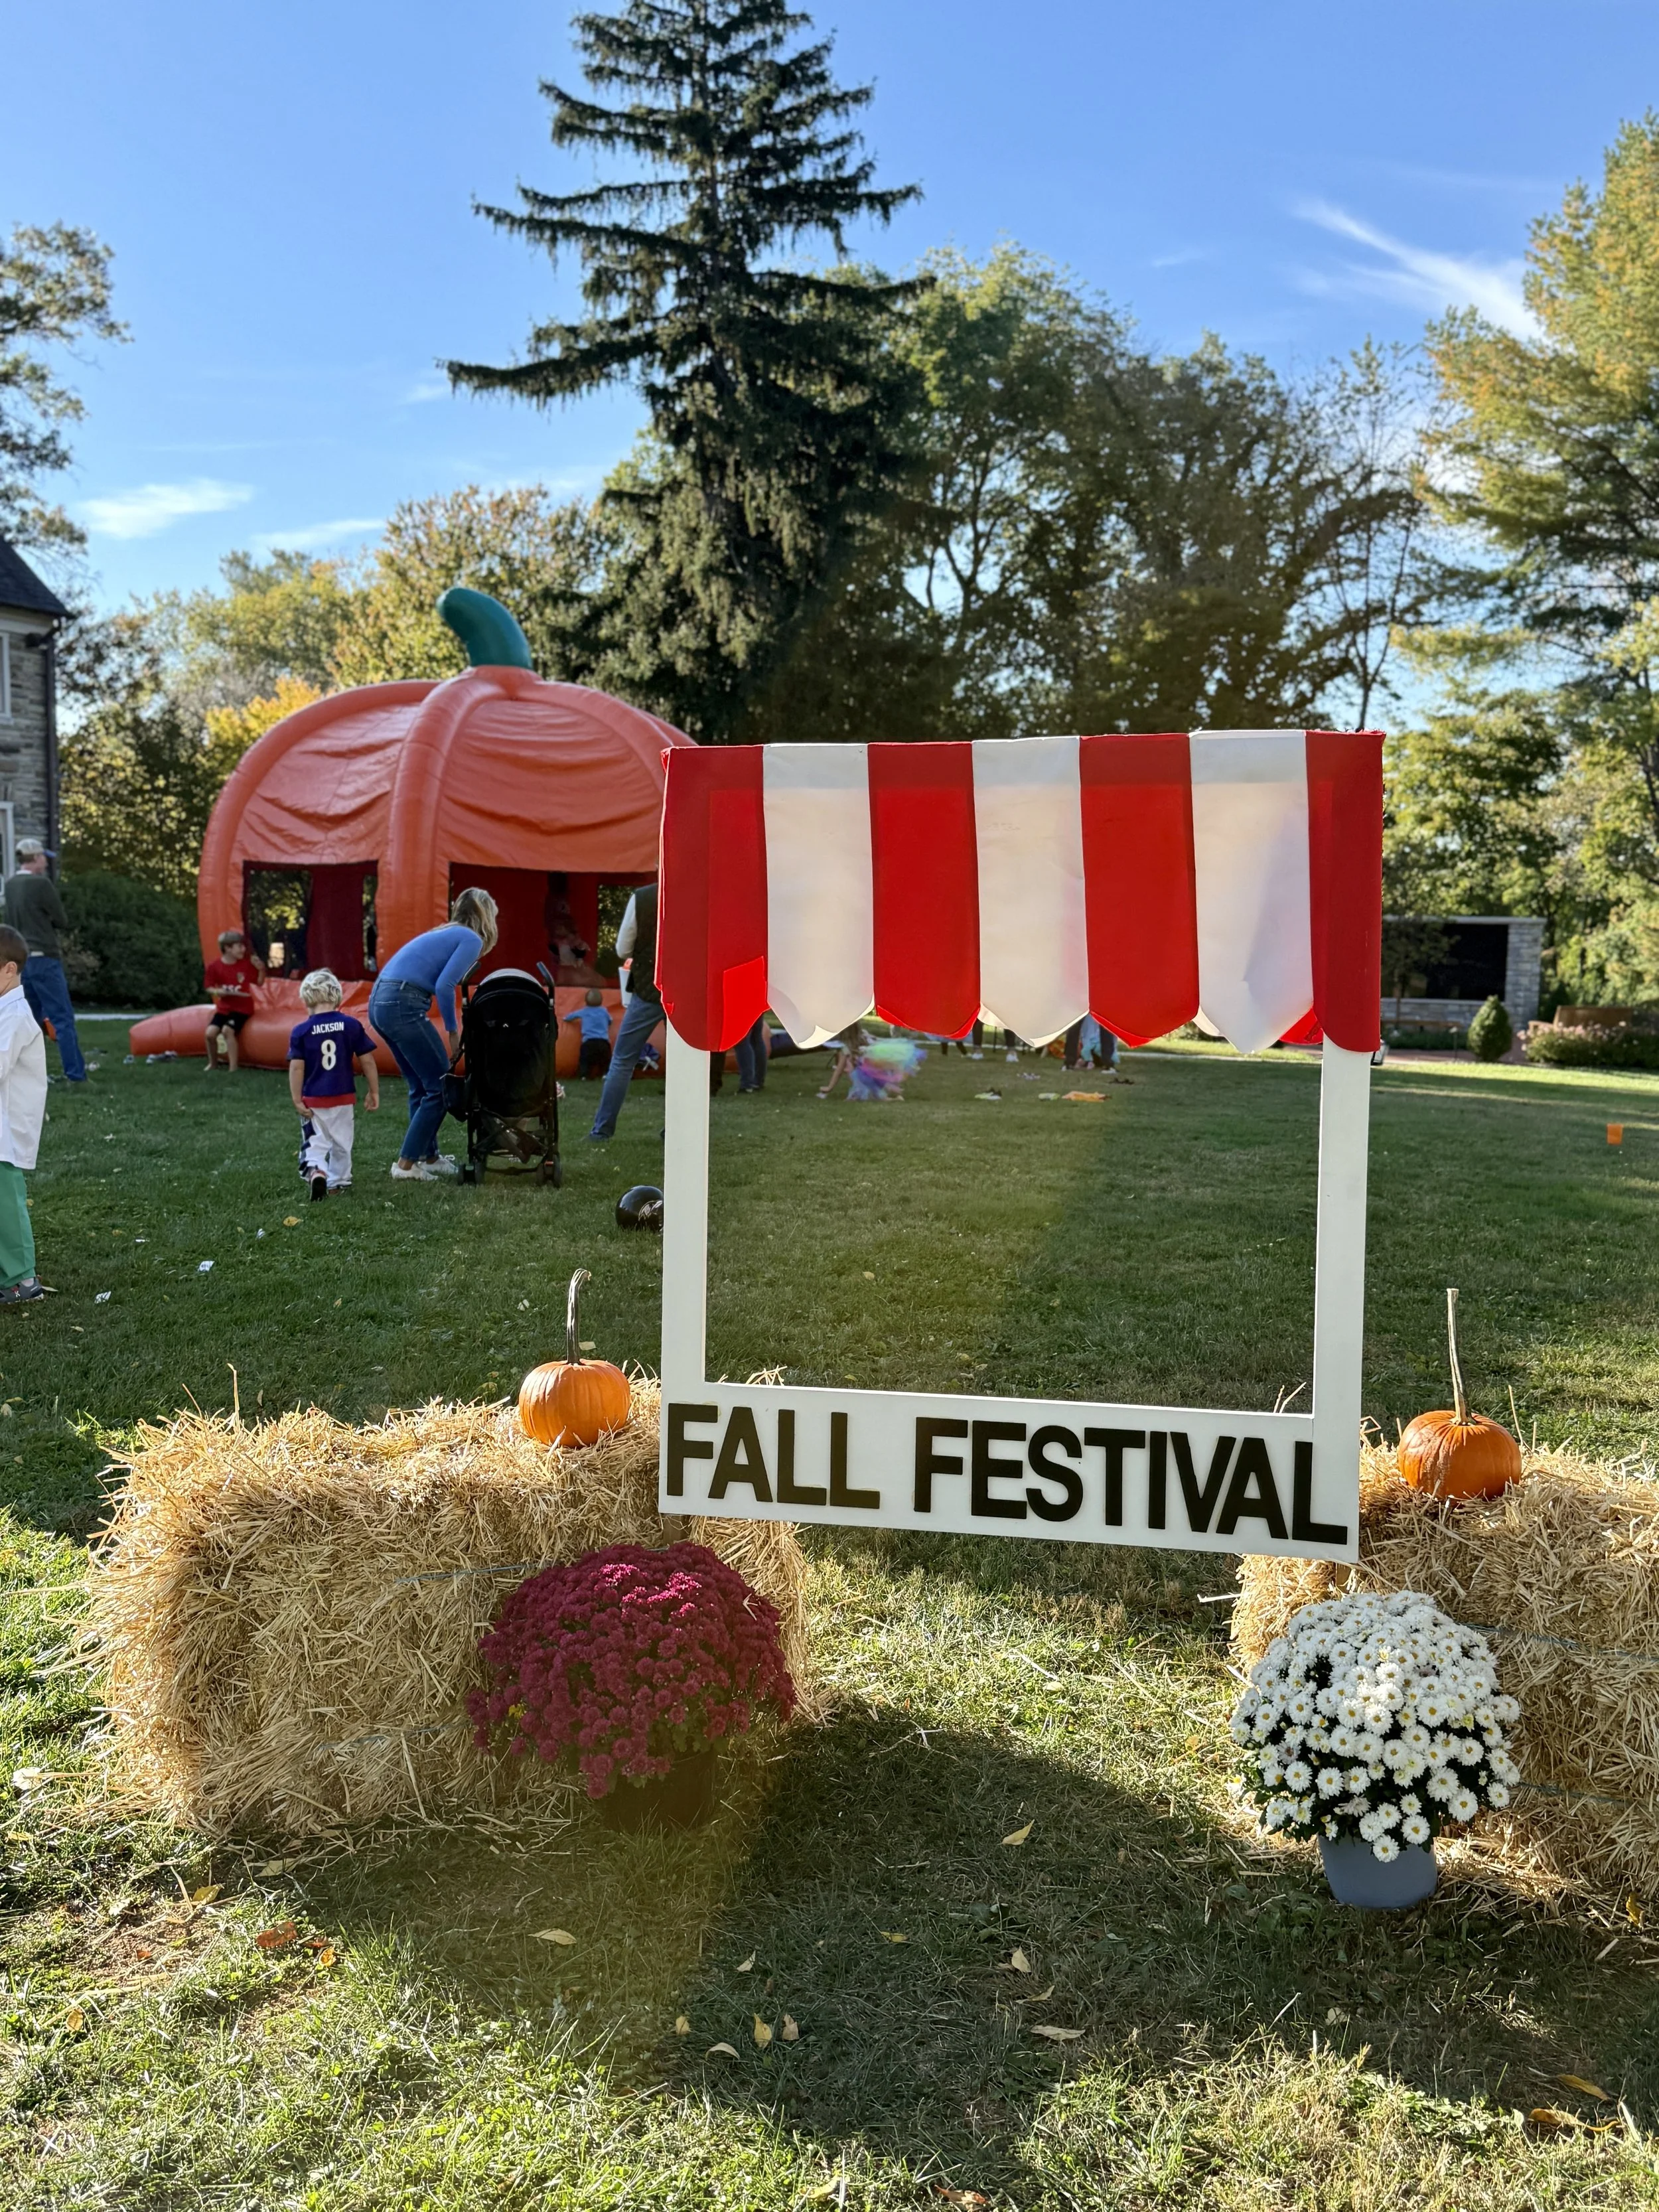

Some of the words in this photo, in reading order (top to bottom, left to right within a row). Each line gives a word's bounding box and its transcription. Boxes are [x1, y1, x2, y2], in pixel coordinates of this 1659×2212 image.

[311, 1021, 344, 1035] JACKSON
[321, 1039, 336, 1070] 8
[666, 1402, 881, 1510] FALL
[913, 1416, 1348, 1546] FESTIVAL
